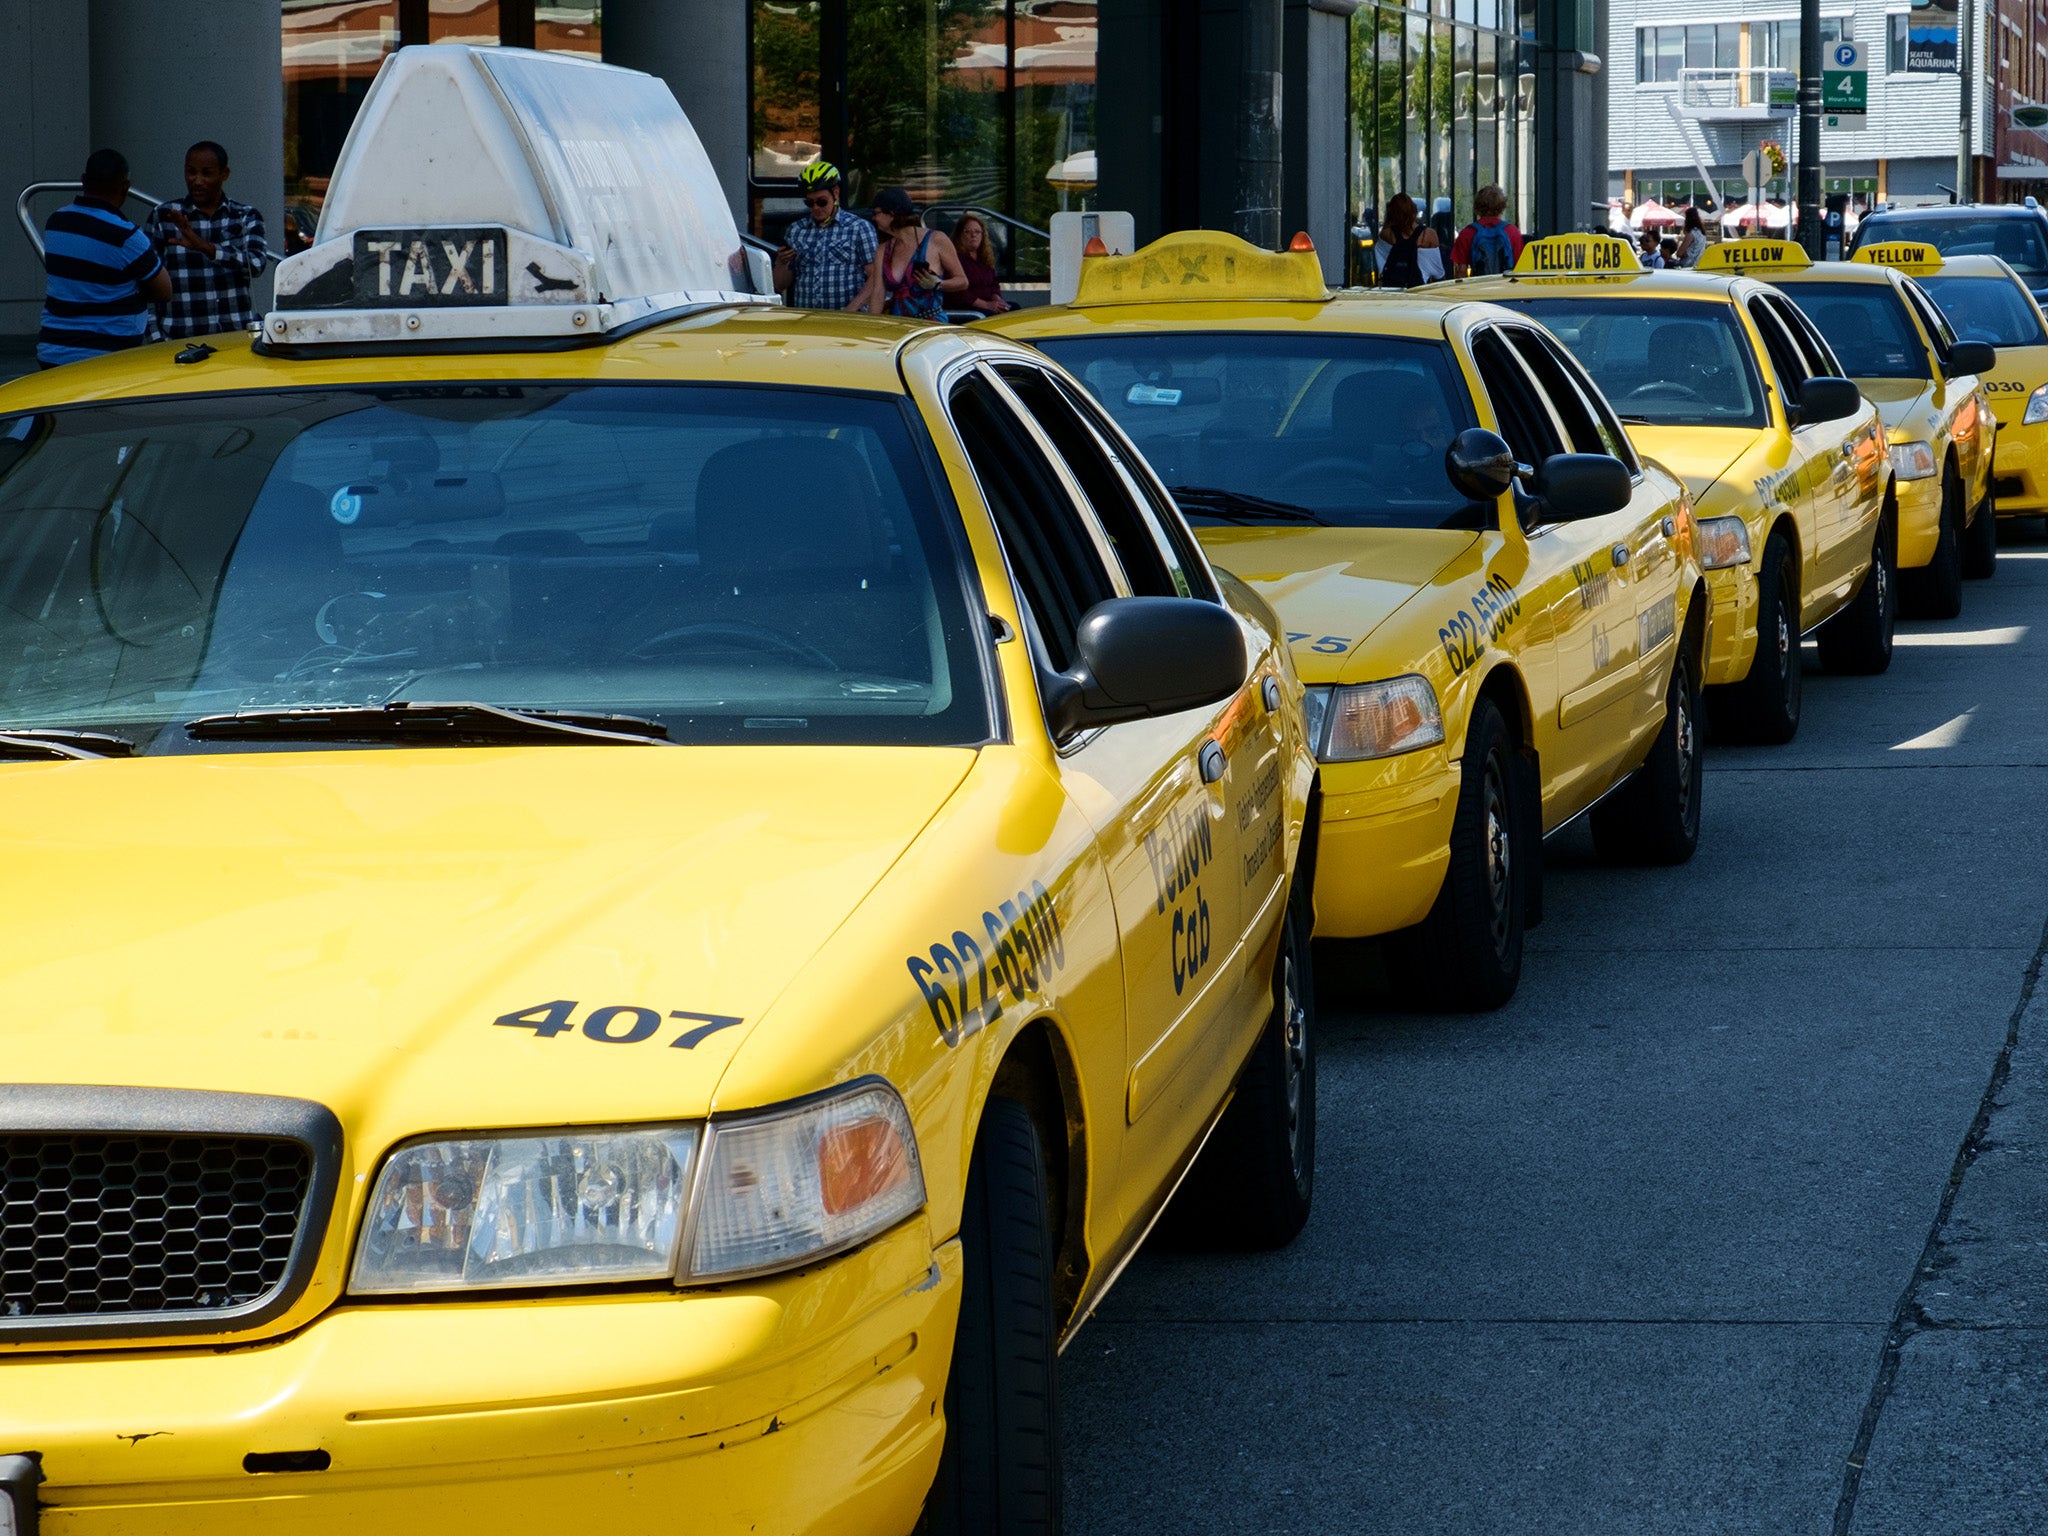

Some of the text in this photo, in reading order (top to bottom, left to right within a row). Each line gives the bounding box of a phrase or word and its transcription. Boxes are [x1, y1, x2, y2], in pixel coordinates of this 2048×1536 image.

[1841, 49, 1853, 63] P
[1909, 50, 1934, 59] SEATTLE
[1909, 58, 1956, 68] AQUARIUM
[1837, 75, 1854, 95] 4
[367, 239, 495, 296] TAXI
[1532, 243, 1621, 270] YELLOW CAB
[1723, 247, 1784, 263] YELLOW
[1868, 248, 1925, 263] YELLOW
[1107, 254, 1236, 291] TAXI
[1438, 573, 1521, 677] 622-6500
[1144, 800, 1213, 916] Yellow
[1172, 887, 1210, 996] Cab
[907, 880, 1065, 1048] 622-6500
[492, 999, 745, 1050] 407
